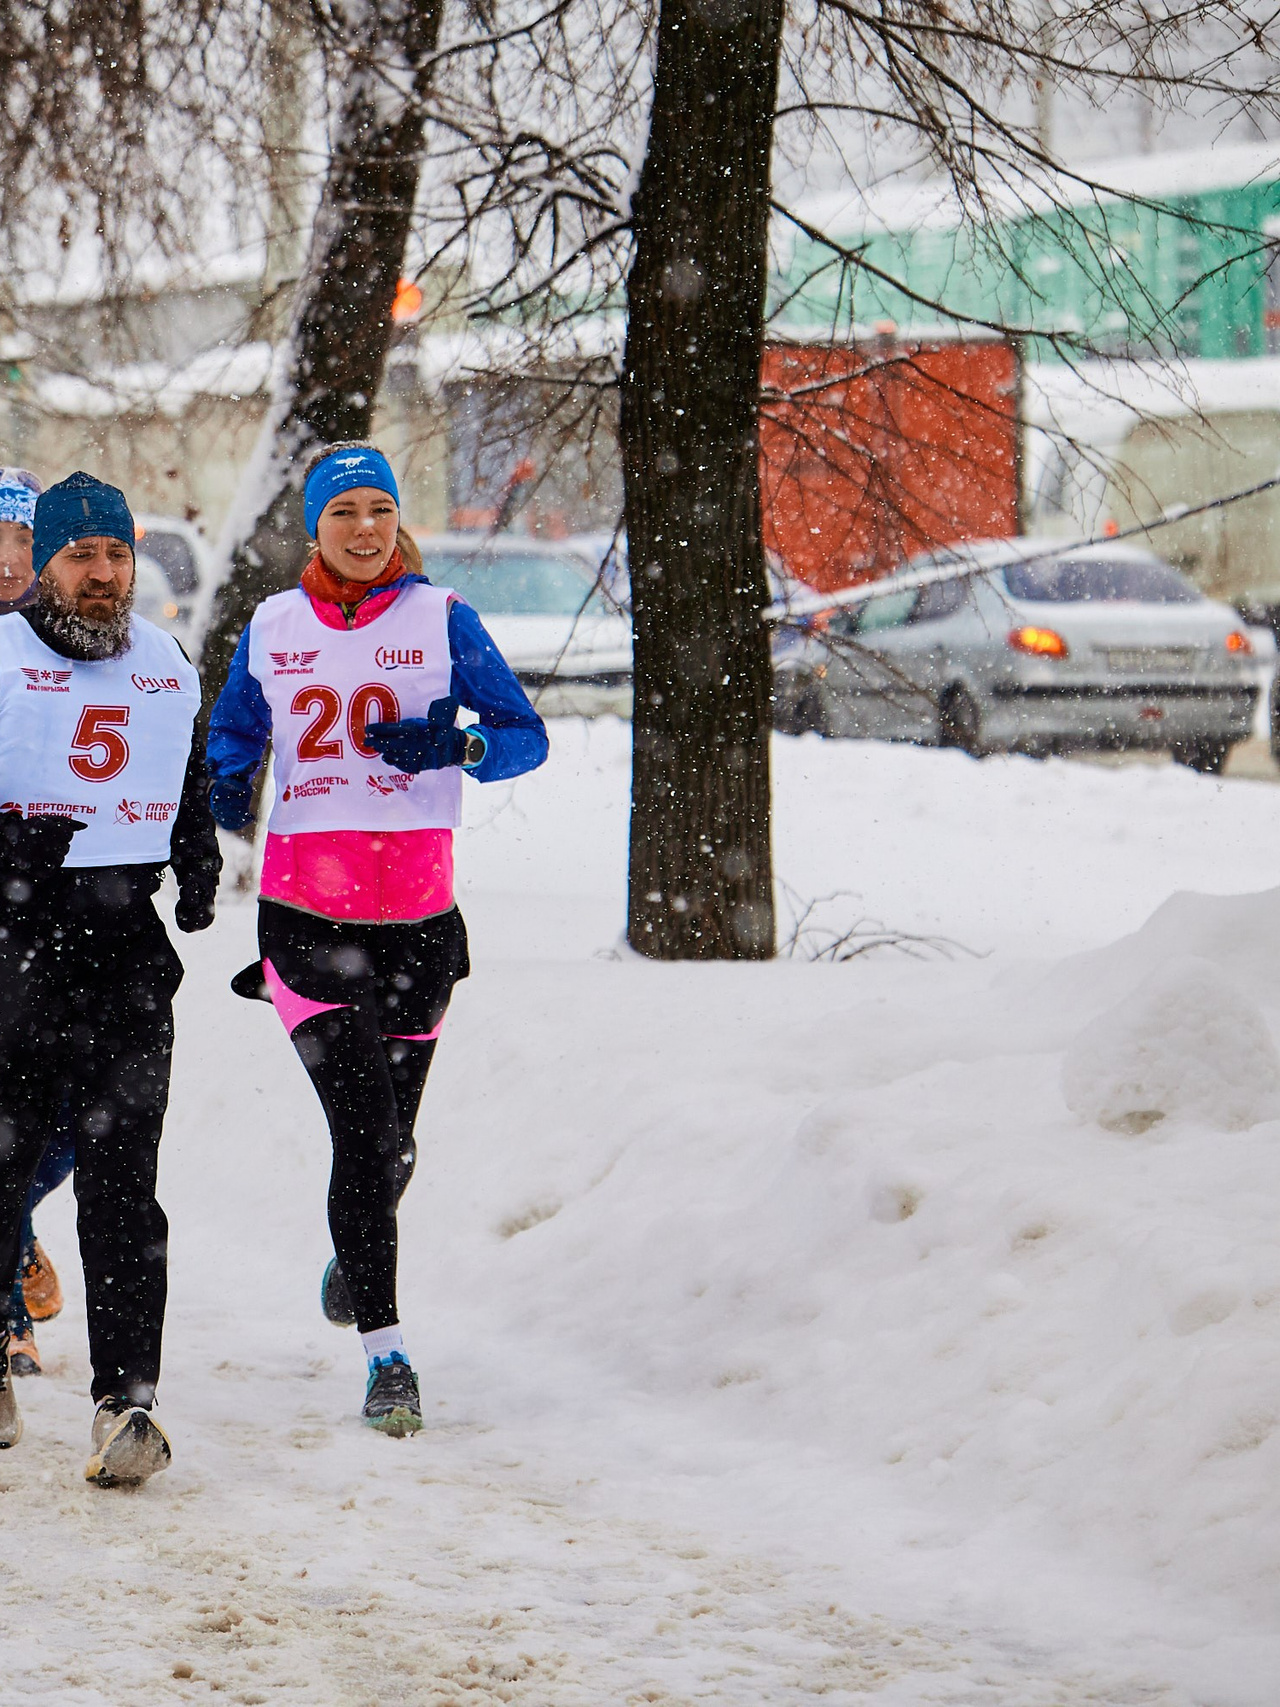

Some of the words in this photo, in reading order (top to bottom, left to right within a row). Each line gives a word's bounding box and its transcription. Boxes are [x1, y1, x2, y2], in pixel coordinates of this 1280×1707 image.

[290, 682, 400, 762] 20
[68, 704, 130, 783] 5
[294, 776, 349, 793] ВЕРТОЛЕТЫ
[27, 802, 97, 815] ВЕРТОЛЕТЫ
[146, 802, 178, 812] ППОО
[145, 812, 169, 823] НЦВ
